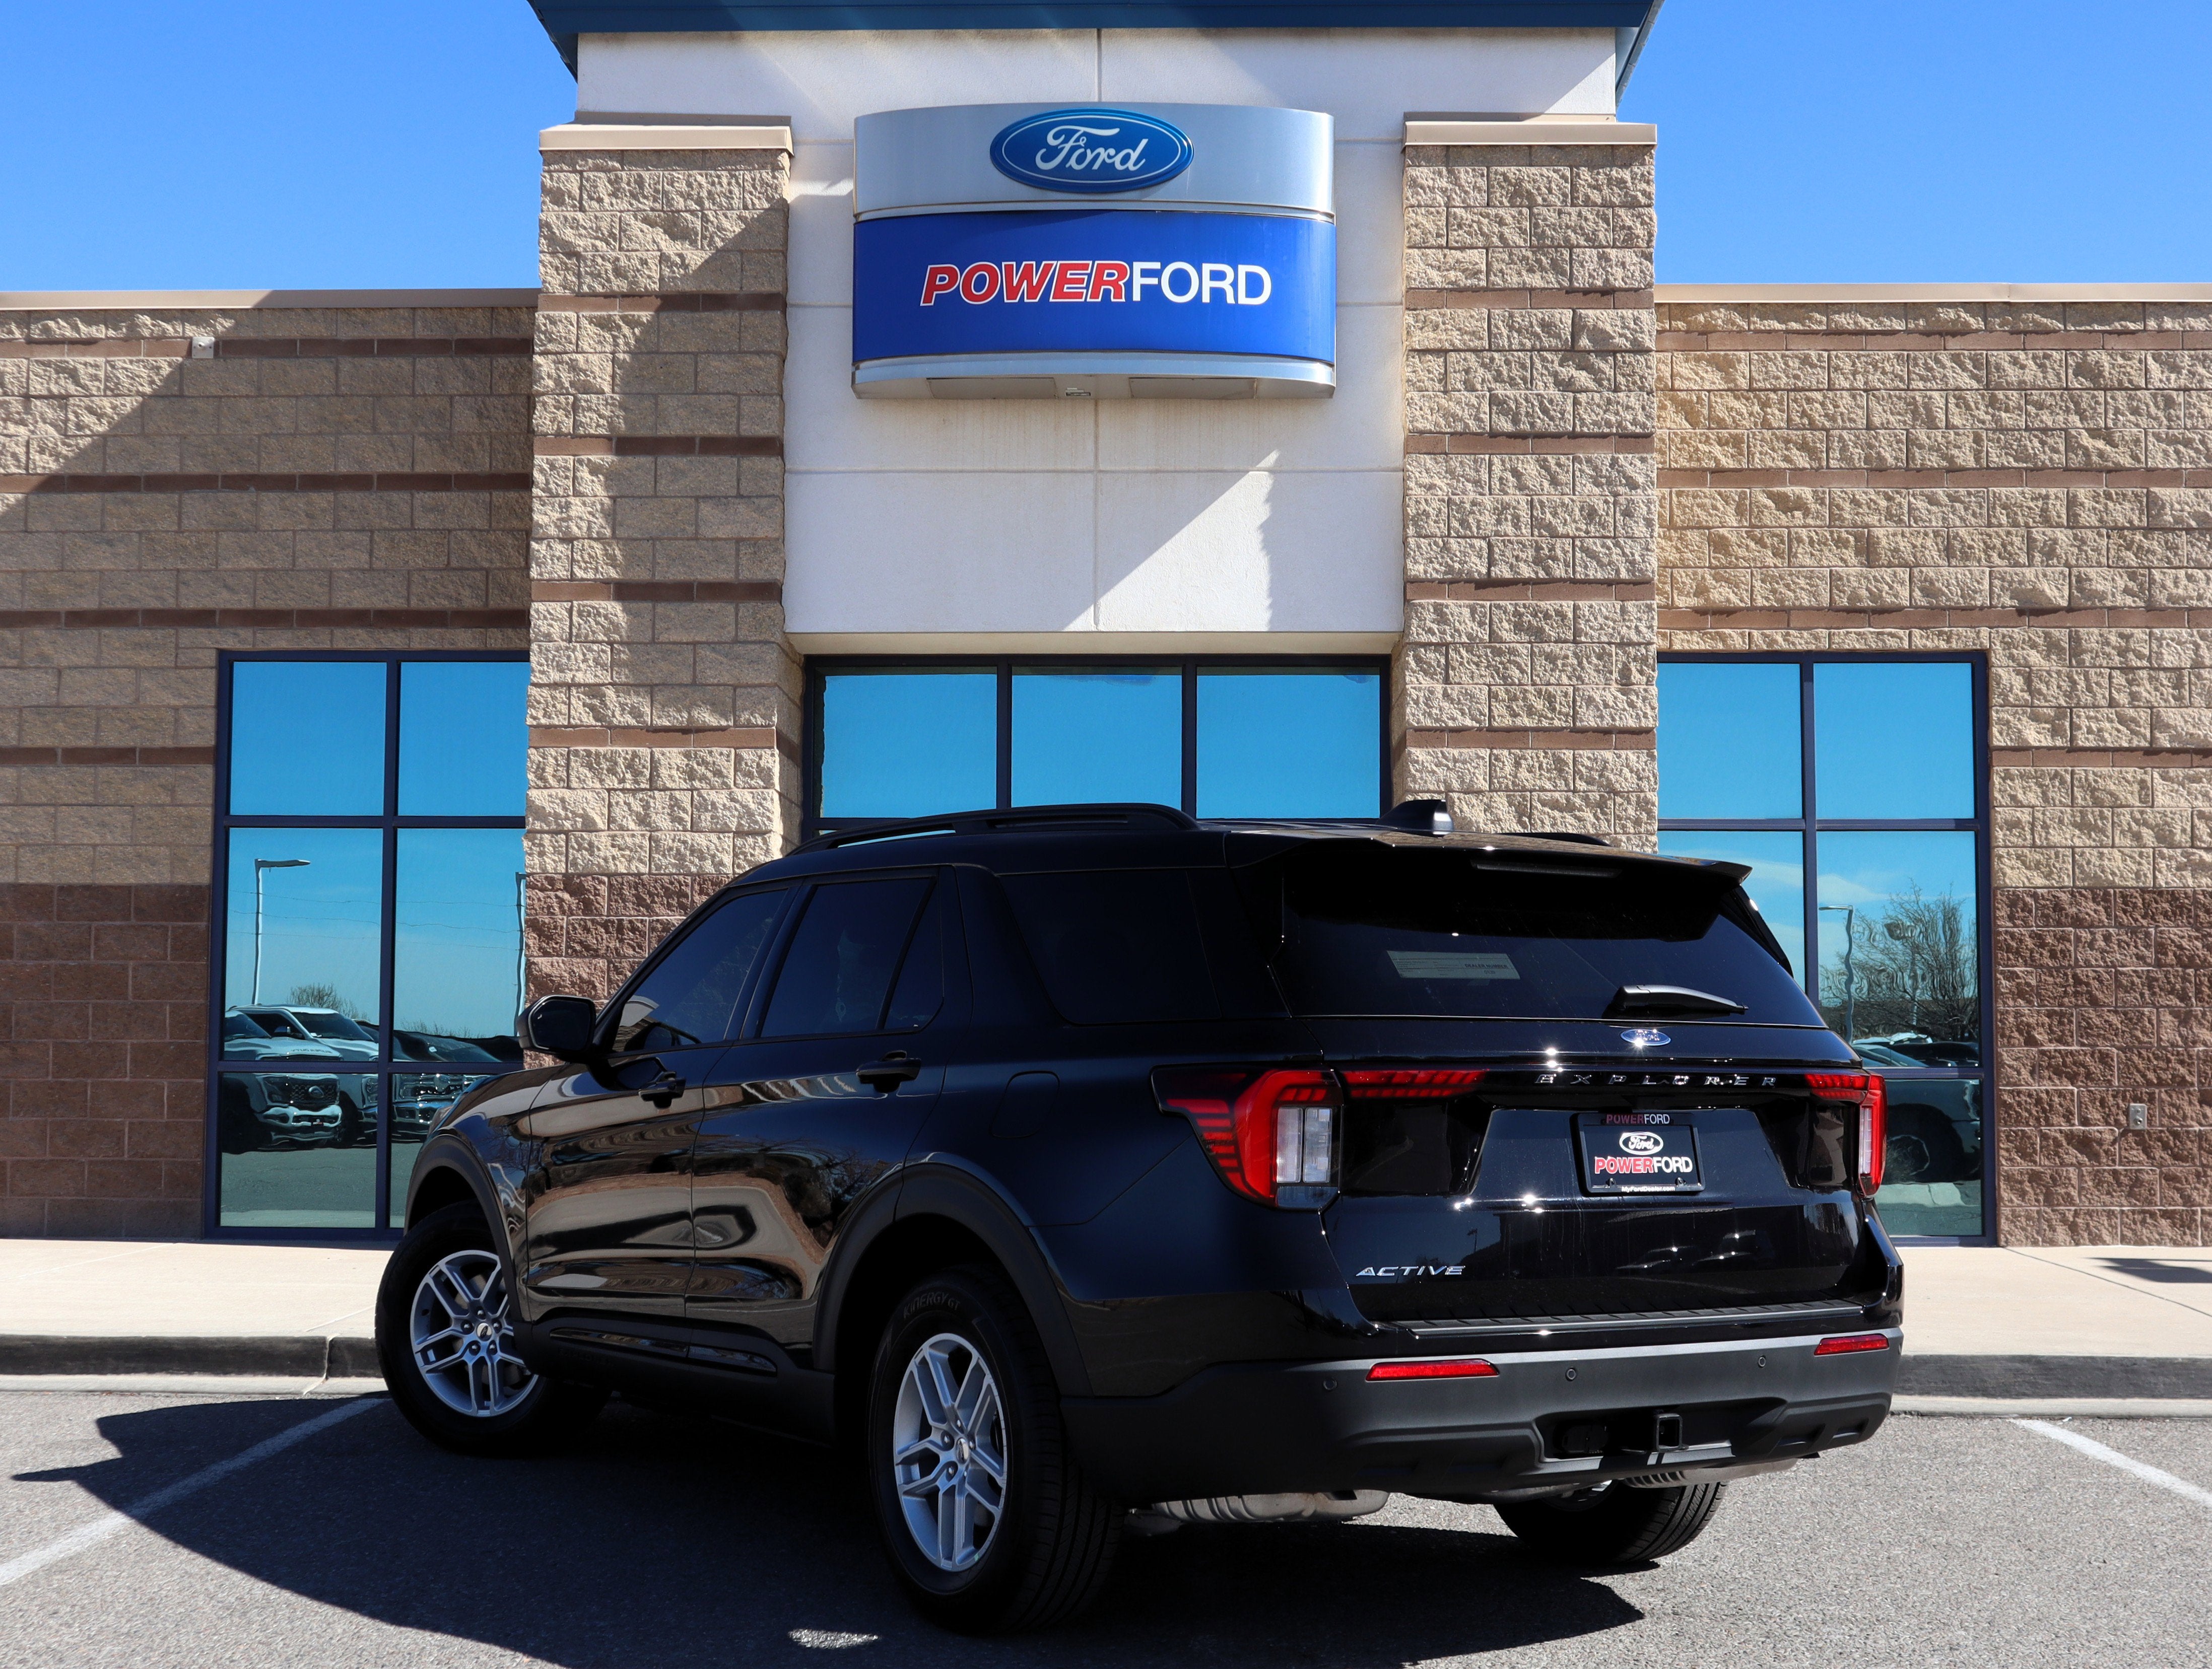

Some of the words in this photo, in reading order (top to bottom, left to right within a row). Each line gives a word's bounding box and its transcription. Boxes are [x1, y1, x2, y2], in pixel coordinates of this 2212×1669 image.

[1035, 124, 1149, 172] Ford
[919, 259, 1272, 307] POWERFORD
[1534, 1074, 1777, 1087] EXPLORER
[1606, 1114, 1670, 1125] POWERFORD
[1628, 1135, 1655, 1150] Ford
[1594, 1156, 1693, 1174] POWERFORD
[1355, 1265, 1466, 1277] ACTIVE
[903, 1291, 949, 1319] KINERGY
[948, 1297, 961, 1311] GT
